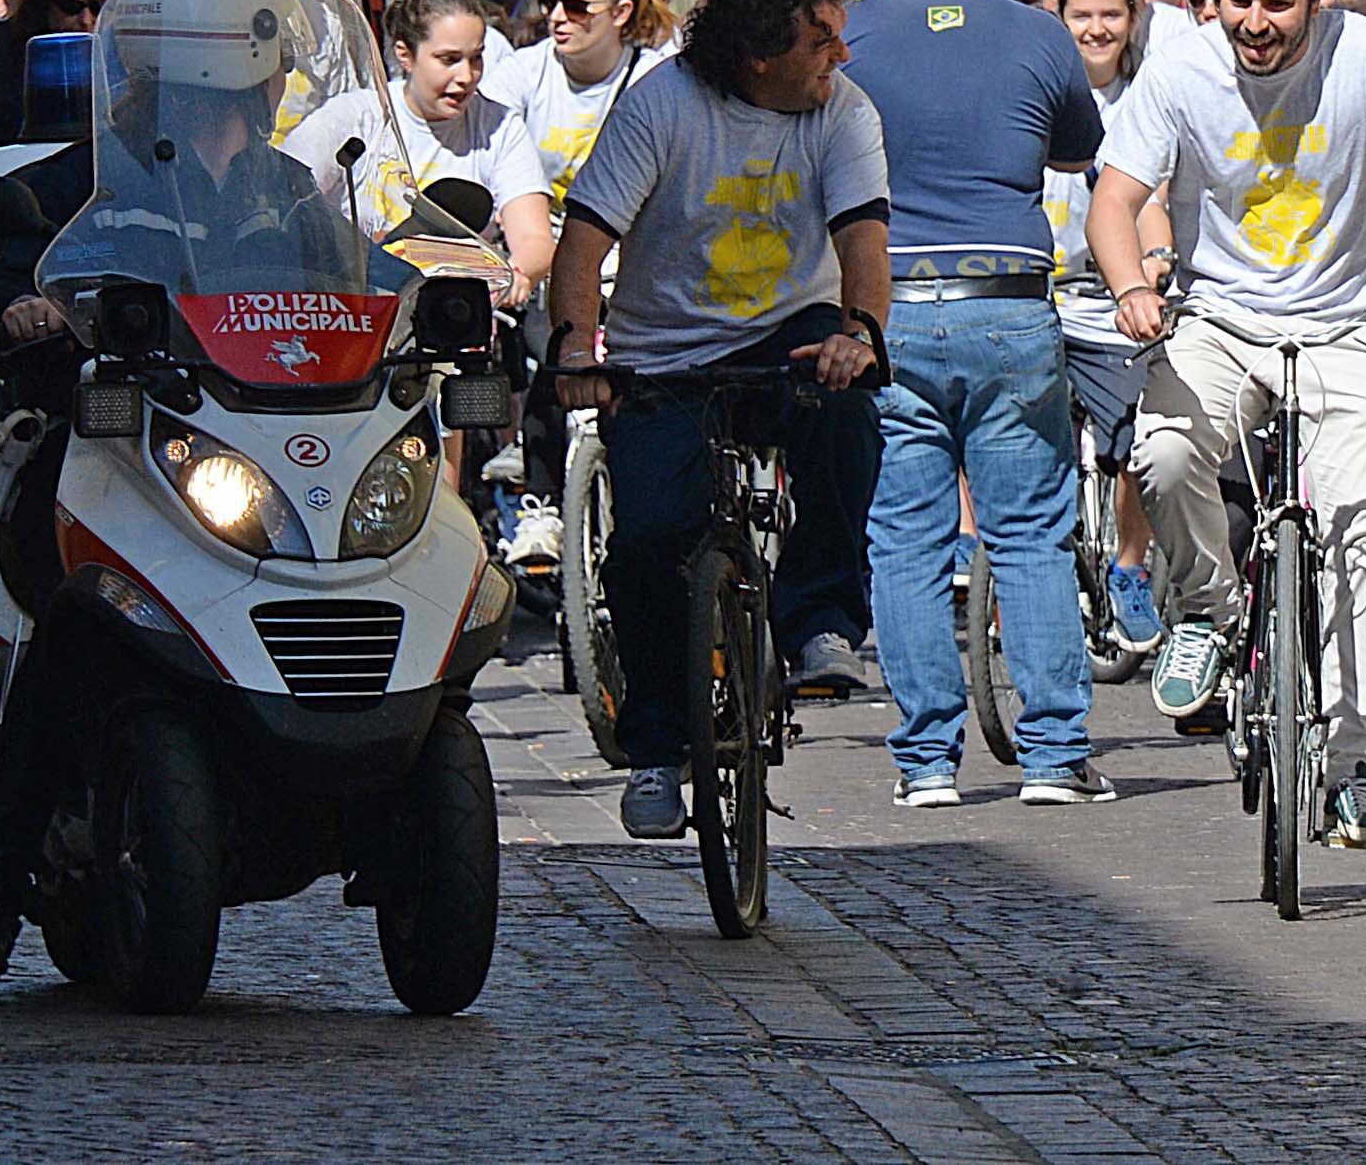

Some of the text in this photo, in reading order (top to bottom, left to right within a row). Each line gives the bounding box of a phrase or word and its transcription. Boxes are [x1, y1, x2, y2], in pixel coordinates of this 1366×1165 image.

[228, 294, 351, 313] POLIZIA
[211, 313, 374, 334] MUNICIPALE
[297, 441, 319, 460] 2
